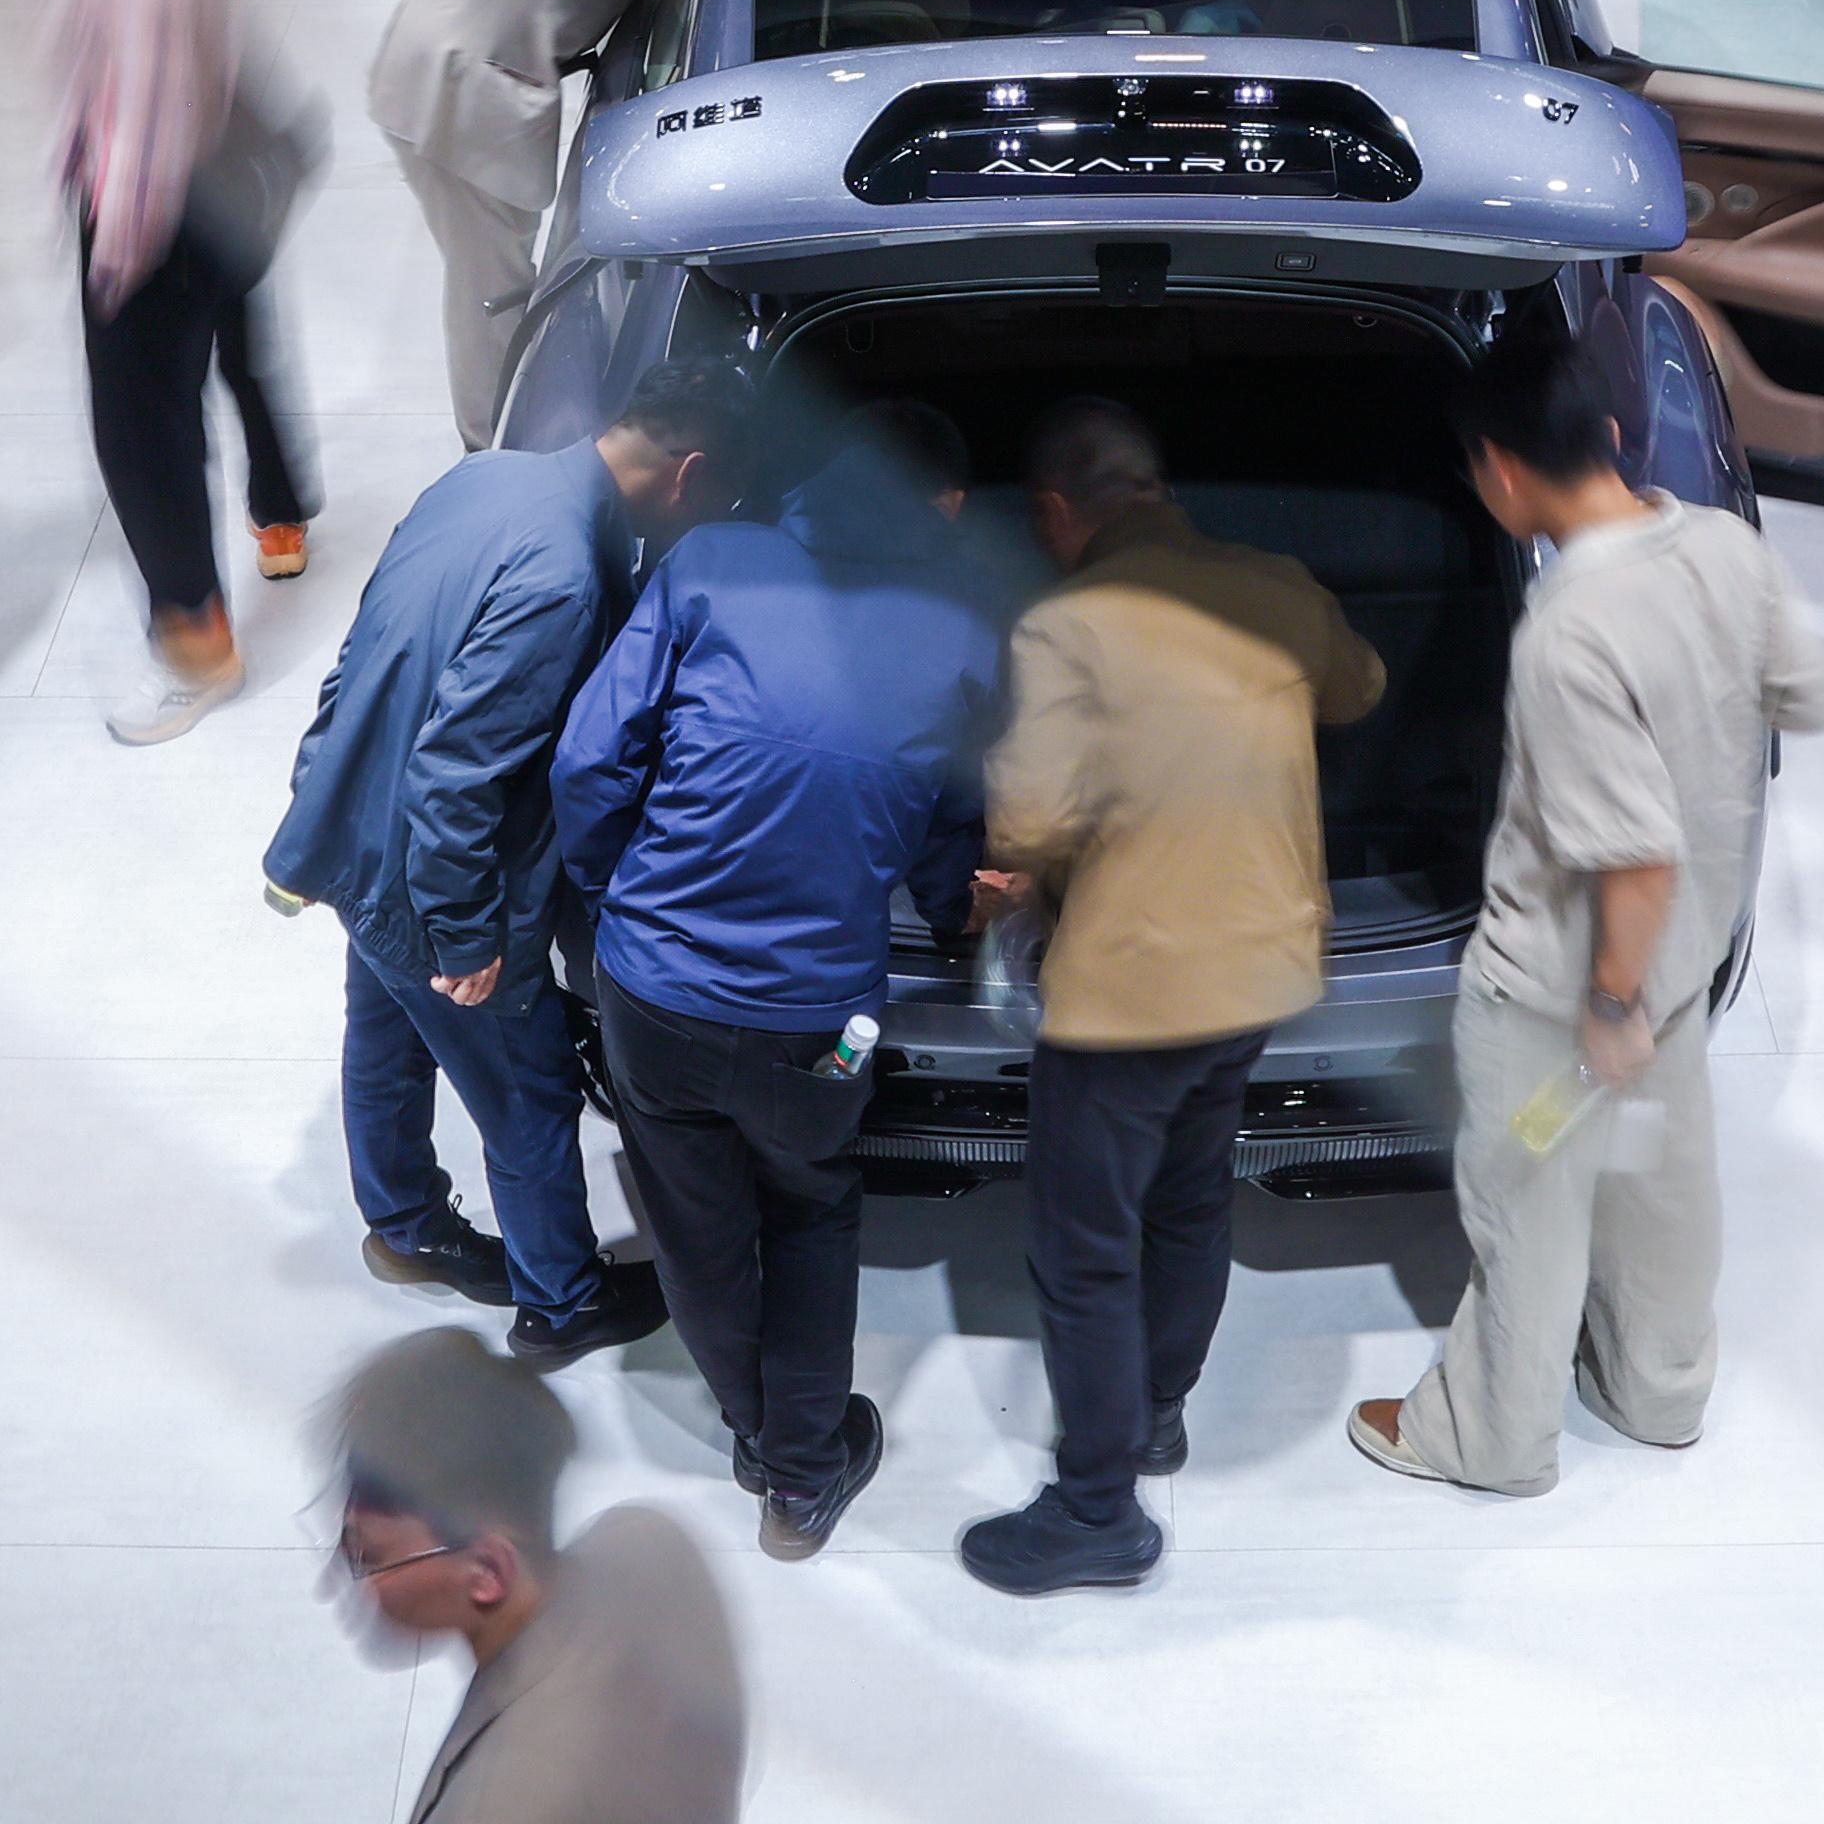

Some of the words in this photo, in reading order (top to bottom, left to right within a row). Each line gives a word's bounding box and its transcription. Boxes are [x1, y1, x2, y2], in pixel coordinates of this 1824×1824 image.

[656, 95, 762, 138] 阿维塔
[1542, 97, 1580, 125] 07
[979, 157, 1227, 174] AVATR
[1245, 159, 1286, 173] 07
